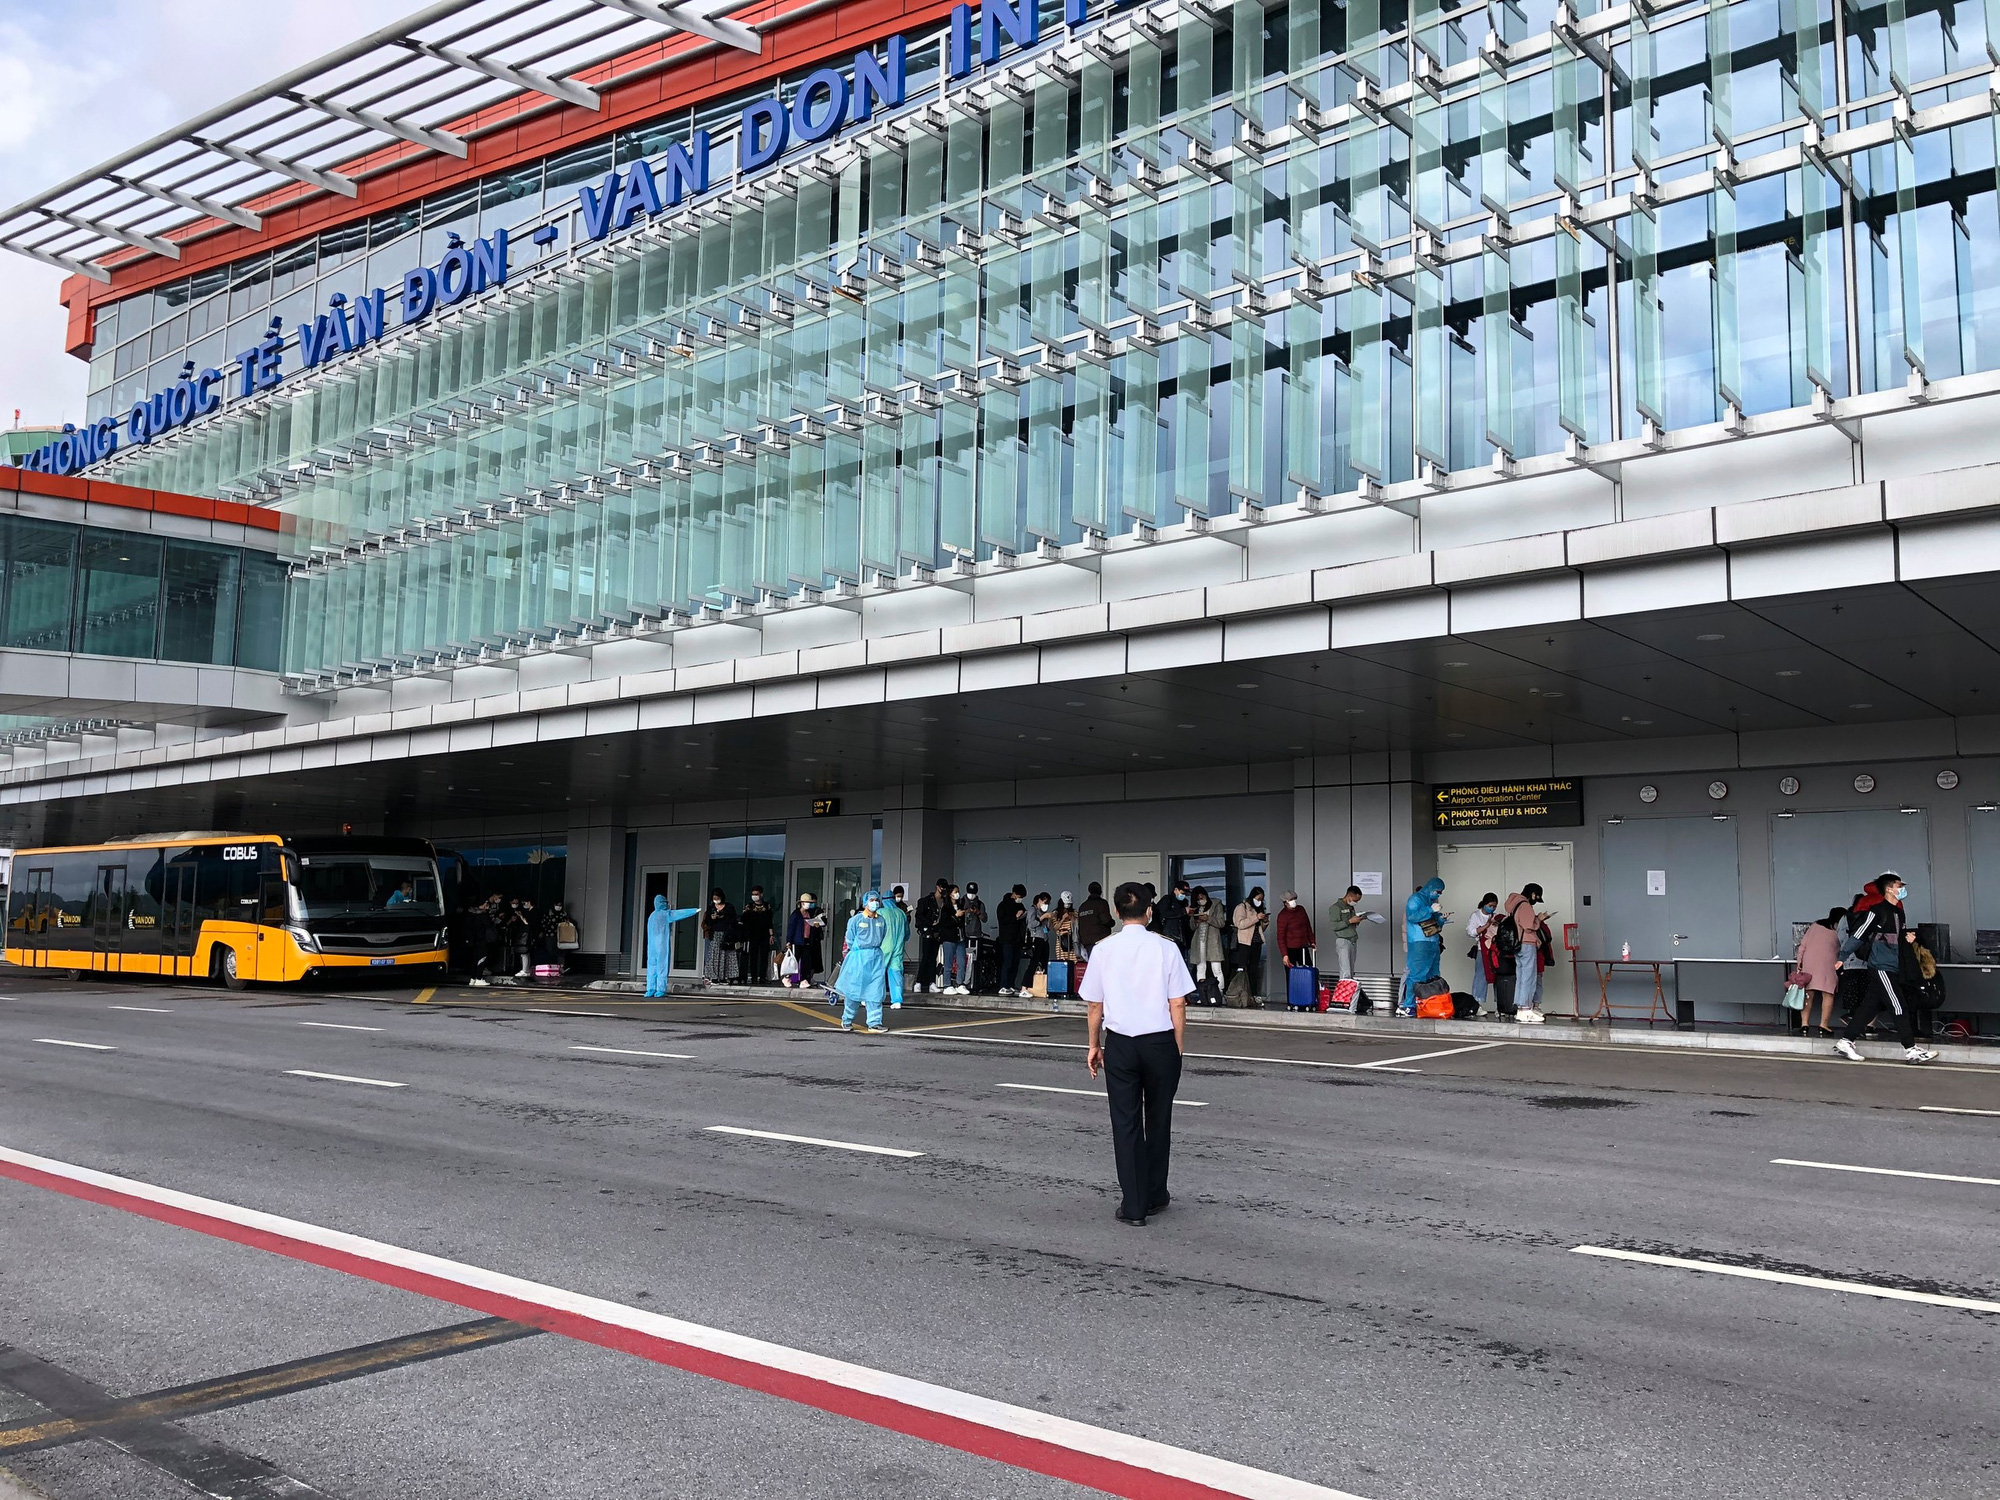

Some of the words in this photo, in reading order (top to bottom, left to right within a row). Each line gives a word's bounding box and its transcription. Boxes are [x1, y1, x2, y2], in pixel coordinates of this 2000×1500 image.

[22, 423, 118, 475] KHÔNG
[128, 360, 221, 445] QUỐC
[236, 316, 283, 397] TẾ
[298, 288, 385, 368] VÂN
[401, 228, 508, 326] ĐỒN
[578, 130, 710, 241] VAN
[741, 34, 907, 175] DON
[1450, 786, 1479, 796] PHÒNG
[1527, 783, 1547, 792] KHAI
[1451, 796, 1475, 805] Airport
[1477, 794, 1513, 804] Operation
[1515, 793, 1541, 802] Center
[825, 800, 832, 813] 7
[1451, 809, 1479, 818] PHÒNG
[1481, 808, 1495, 817] TÀI
[1516, 808, 1522, 816] &
[1524, 807, 1548, 815] HDCX
[1451, 818, 1470, 827] Load
[1472, 817, 1499, 826] Control
[223, 846, 258, 861] COBUS
